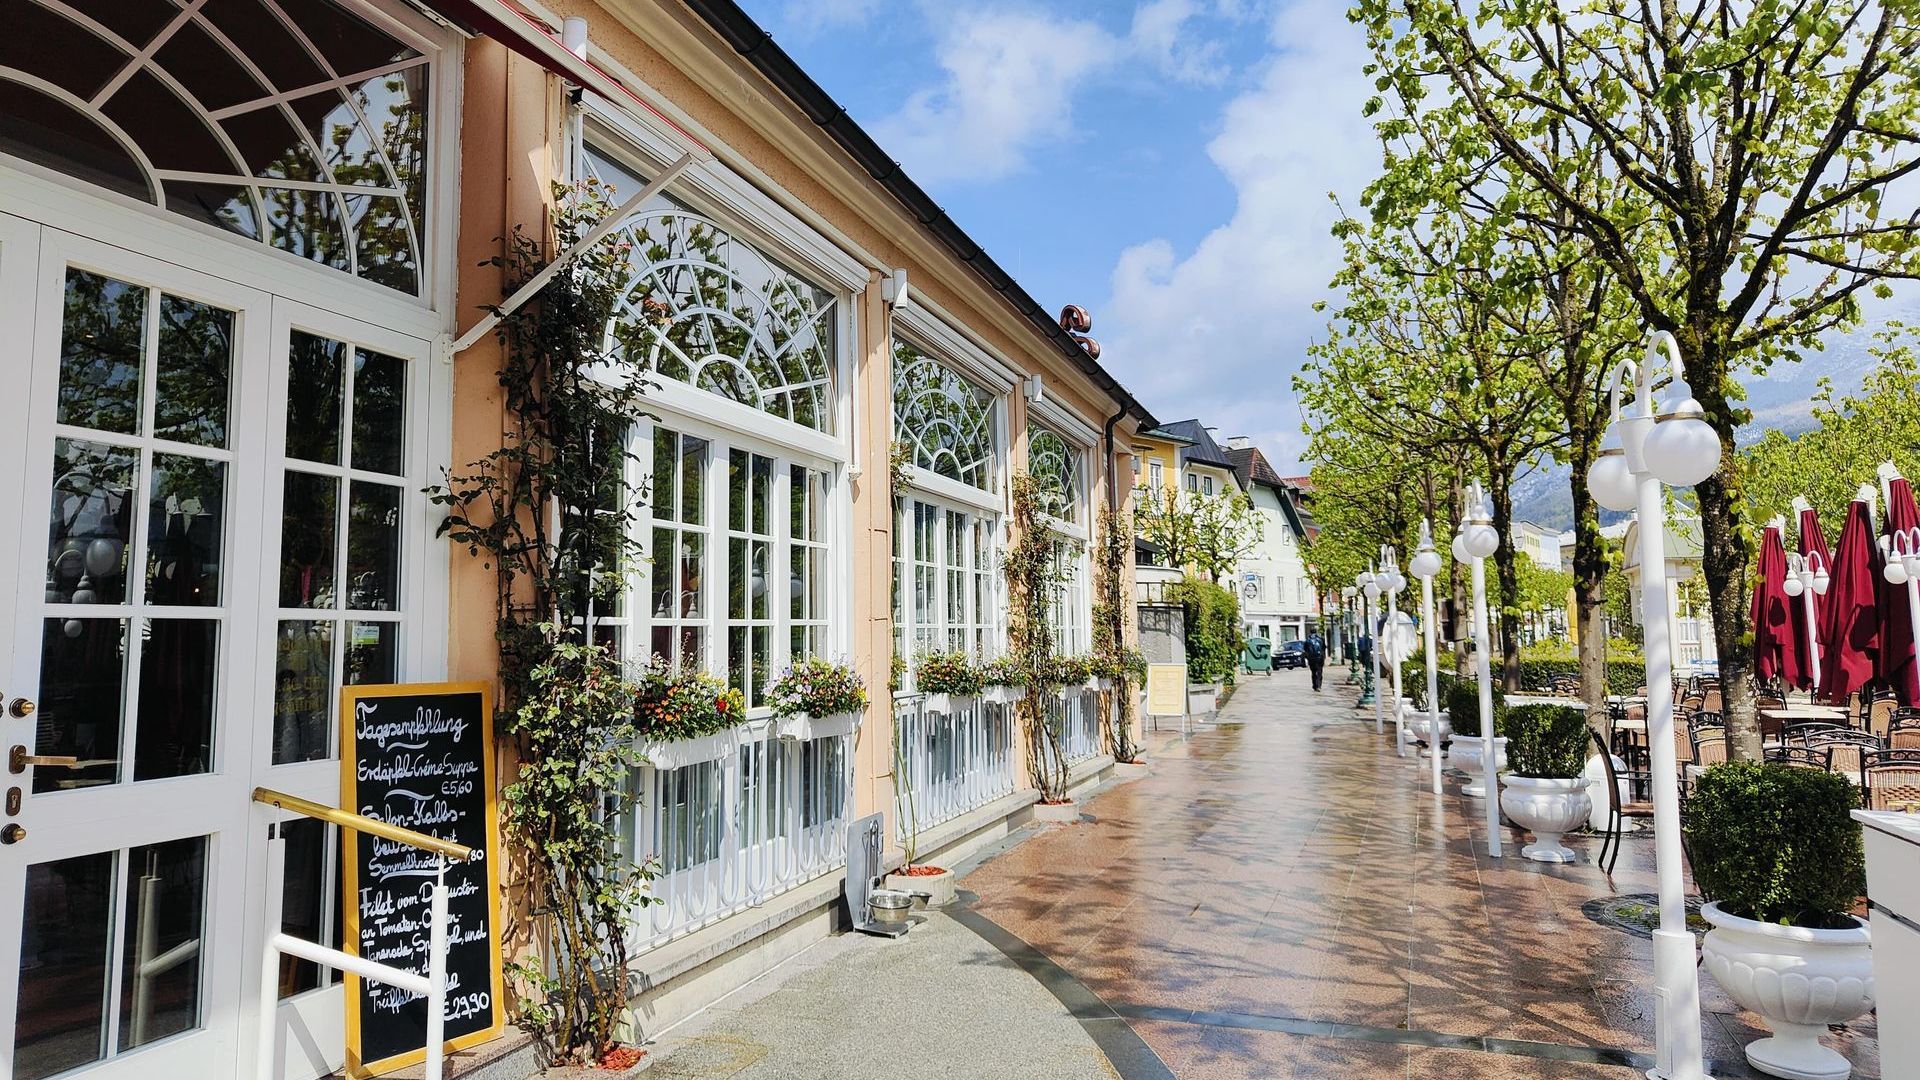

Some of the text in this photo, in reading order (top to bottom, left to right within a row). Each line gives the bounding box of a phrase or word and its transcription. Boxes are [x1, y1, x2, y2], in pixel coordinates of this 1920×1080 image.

[356, 701, 469, 748] Tagesempfehlung
[441, 780, 473, 798] €5,60
[368, 852, 447, 877] Semmelknöde
[359, 887, 396, 919] Filet
[397, 894, 418, 910] vom
[361, 908, 462, 939] an Tomaten-Oen-
[411, 924, 464, 957] Spgel,
[464, 919, 487, 942] und
